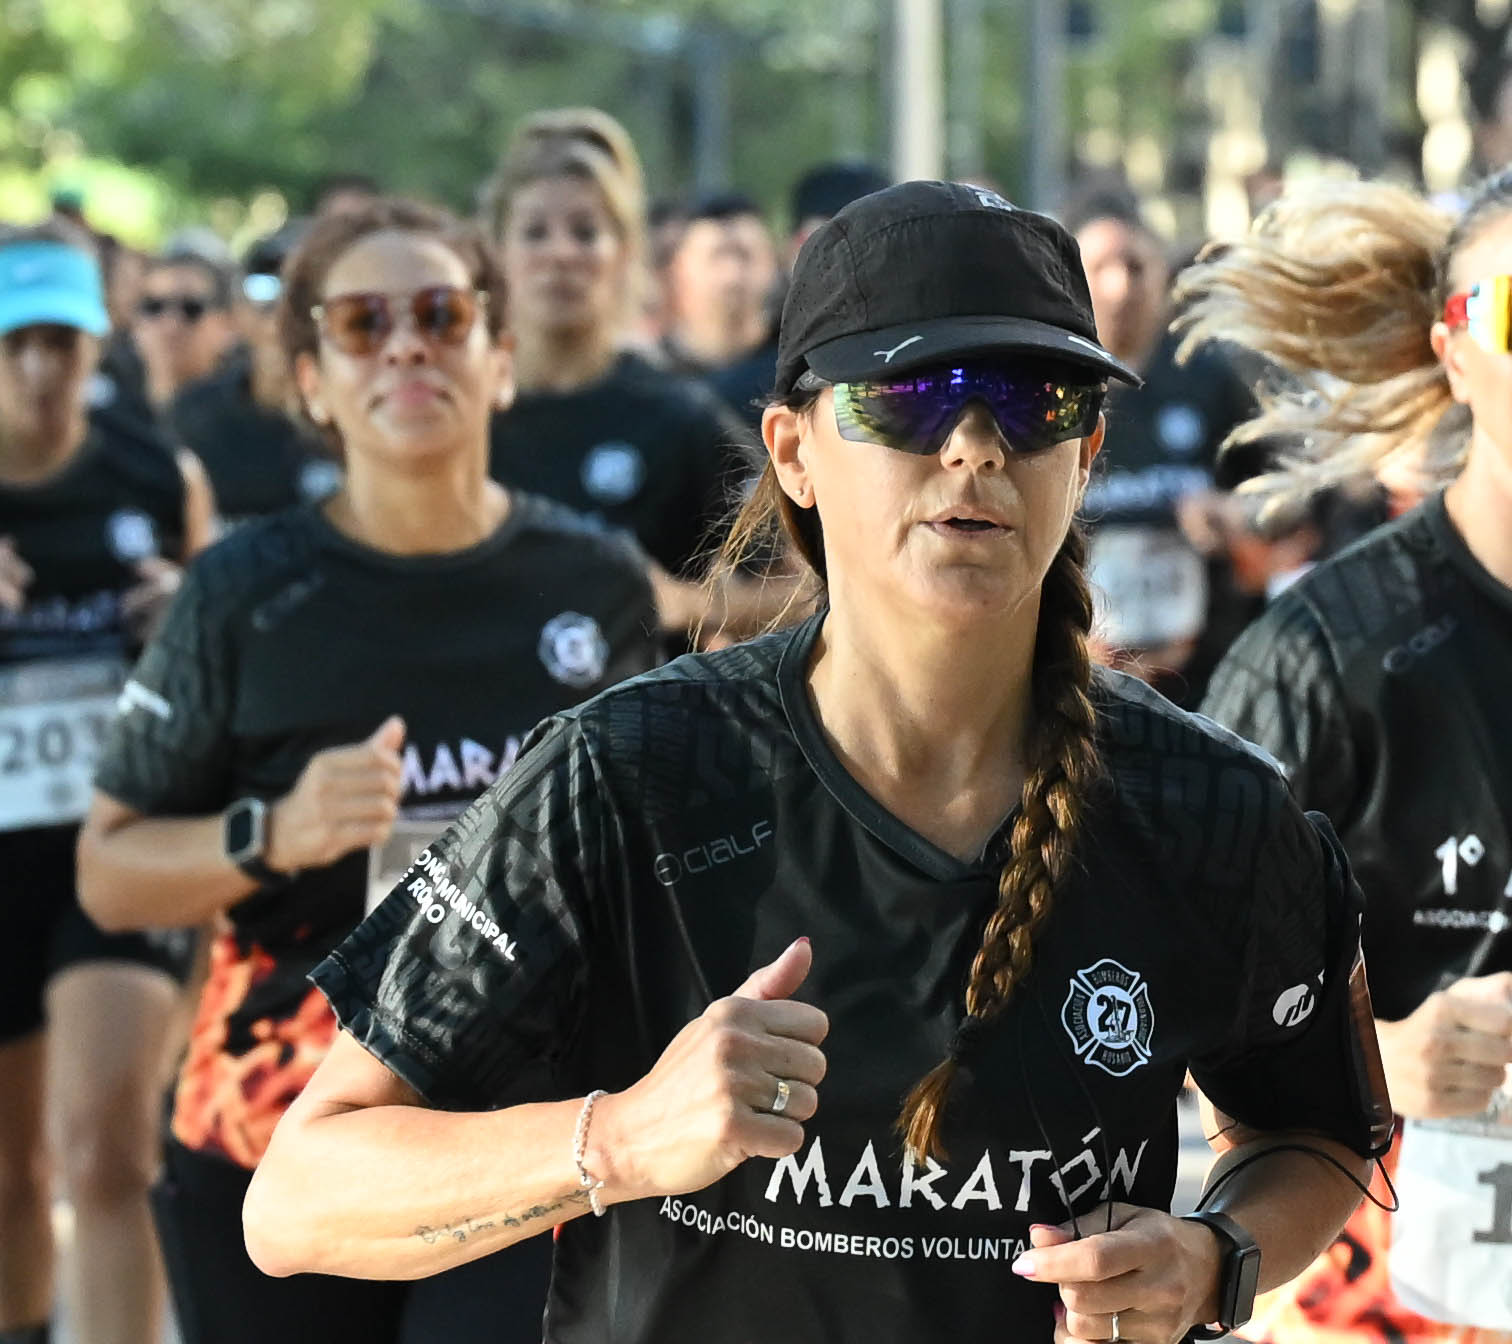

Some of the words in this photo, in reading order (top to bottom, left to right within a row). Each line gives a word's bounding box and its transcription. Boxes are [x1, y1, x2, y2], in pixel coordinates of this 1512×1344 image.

[435, 876, 517, 962] MUNICIPAL
[1096, 993, 1133, 1033] 27
[764, 1127, 1149, 1212] MARATÓN
[659, 1195, 774, 1244] ASOCIACIÓN
[780, 1227, 914, 1259] BOMBEROS
[921, 1236, 1034, 1263] VOLUNTA
